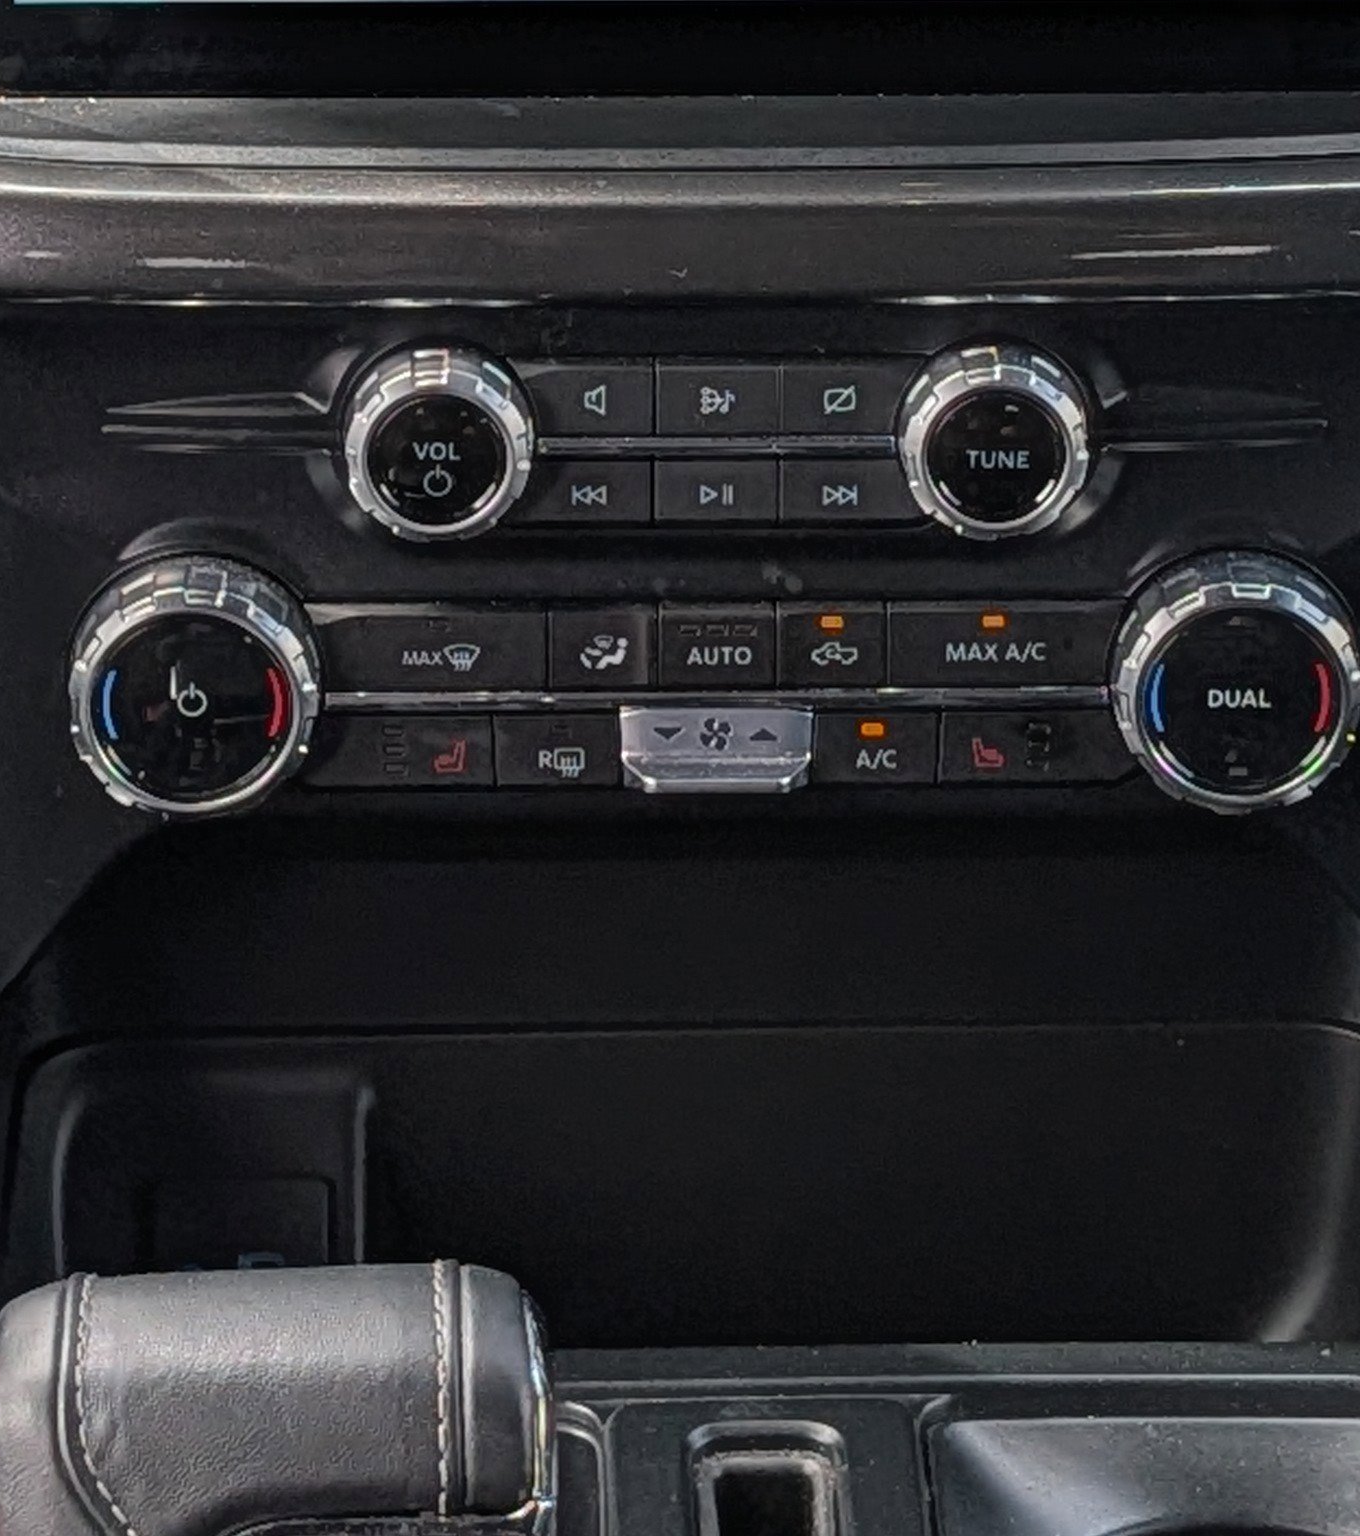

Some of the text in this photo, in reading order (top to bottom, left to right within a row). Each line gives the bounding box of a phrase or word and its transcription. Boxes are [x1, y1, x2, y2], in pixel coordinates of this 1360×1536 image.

[412, 441, 461, 462] VOL
[965, 448, 1031, 471] TUNE
[402, 649, 443, 667] MAX
[686, 644, 753, 667] AUTO
[945, 641, 1048, 664] MAX A/C
[1207, 688, 1272, 710] DUAL
[856, 749, 898, 770] A/C
